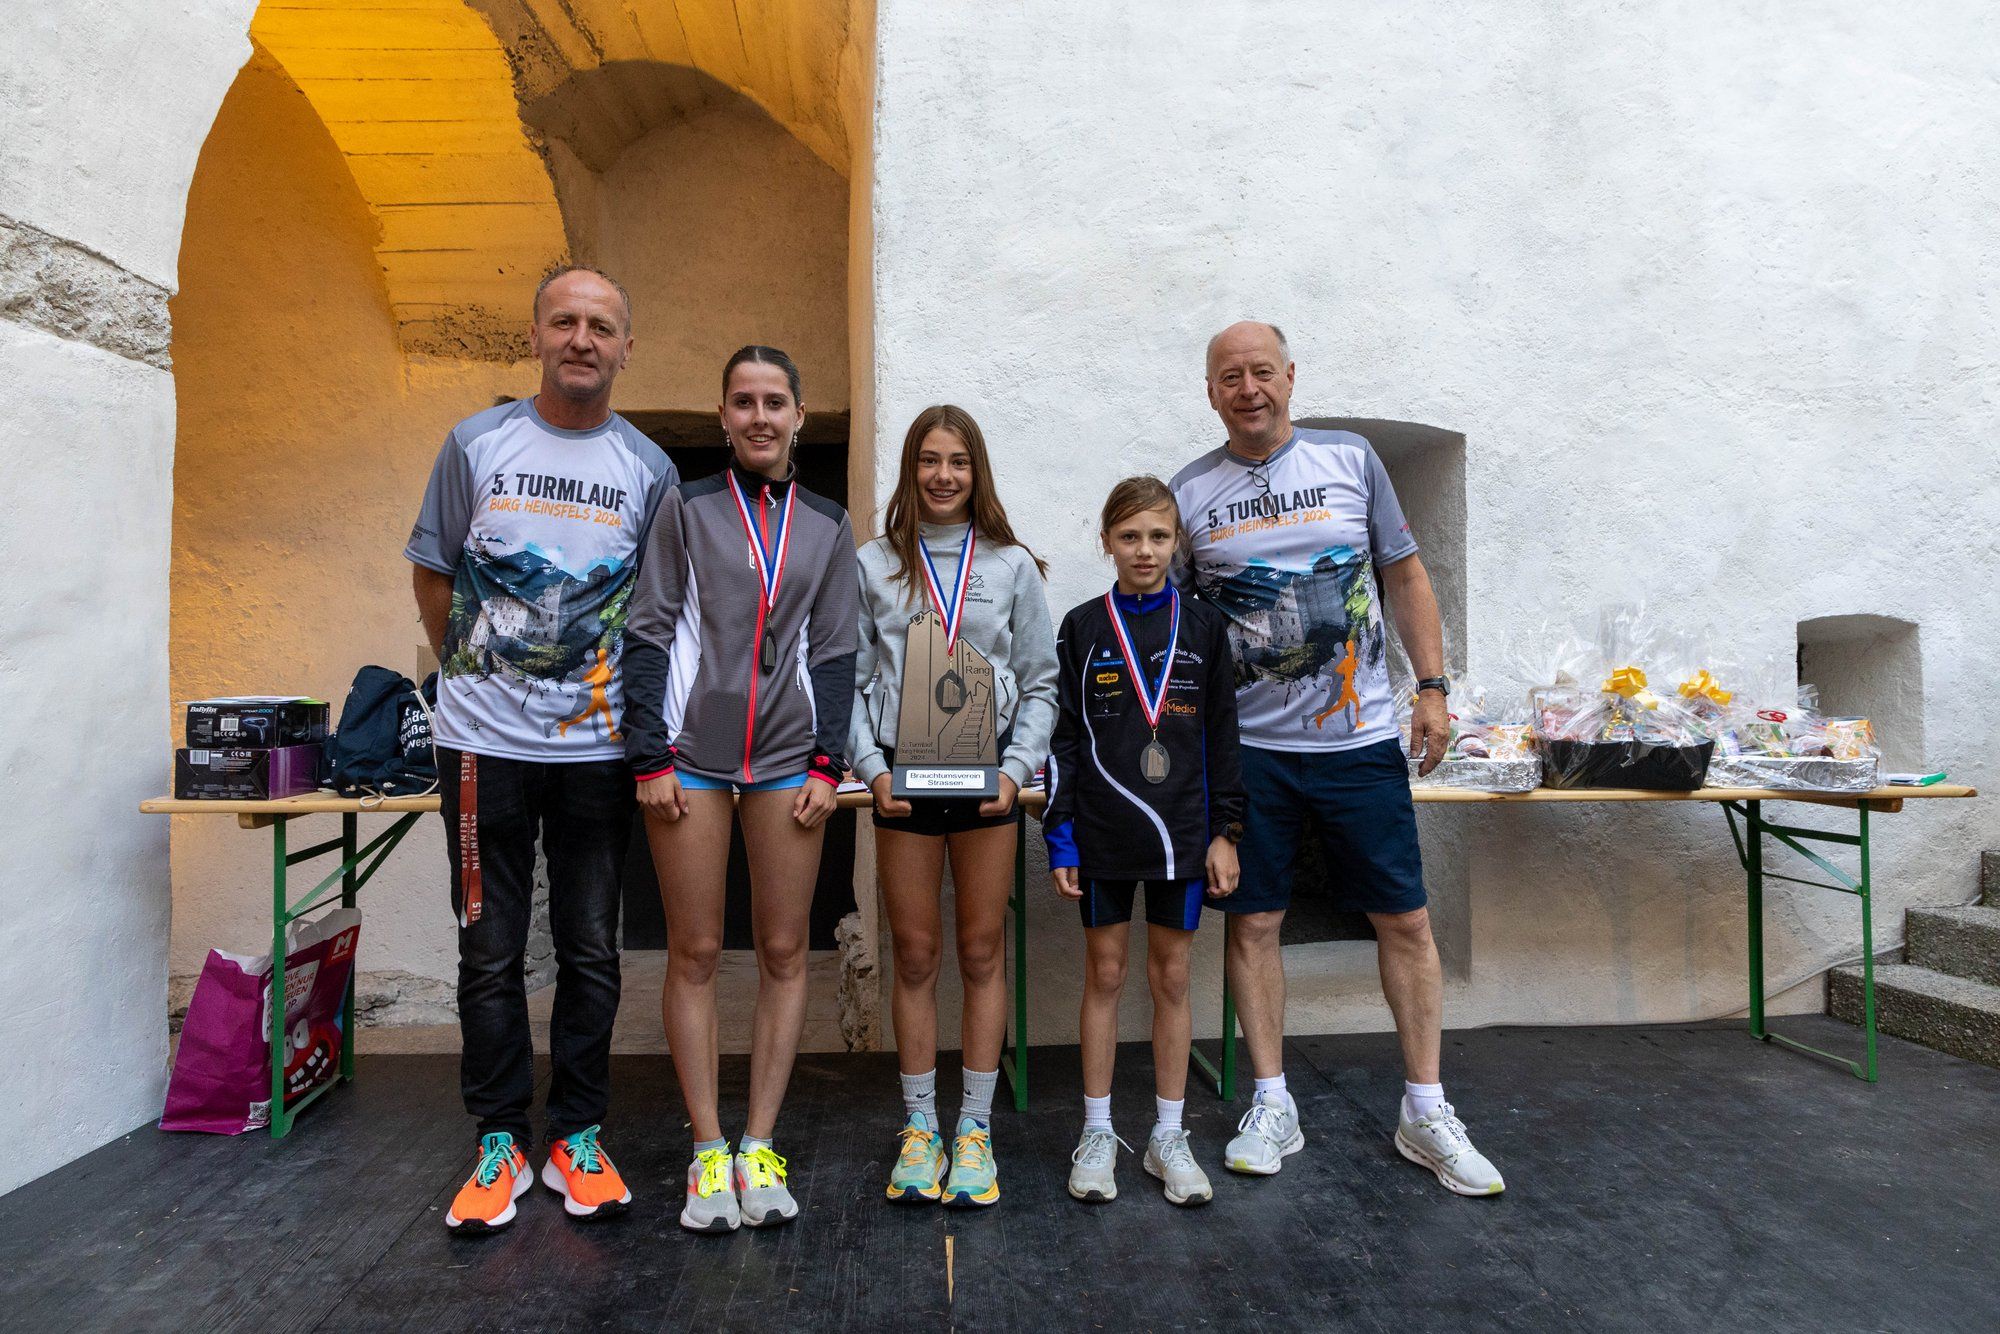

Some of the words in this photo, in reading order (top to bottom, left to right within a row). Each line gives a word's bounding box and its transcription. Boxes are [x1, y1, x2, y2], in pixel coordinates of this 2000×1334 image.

[491, 473, 508, 496] 5.
[516, 473, 627, 512] TURMLAUF
[489, 498, 521, 512] BURG
[524, 500, 591, 521] HEINSFELS
[594, 509, 622, 528] 2024
[1208, 508, 1223, 529] 5.
[1226, 487, 1327, 523] TURMLAUF
[1210, 525, 1235, 544] BURG
[1302, 509, 1332, 523] 2024
[965, 665, 990, 677] Rang
[966, 651, 973, 662] 1.
[1189, 652, 1203, 664] 2000
[1162, 702, 1197, 714] iMedia
[460, 813, 468, 869] HEINFELS
